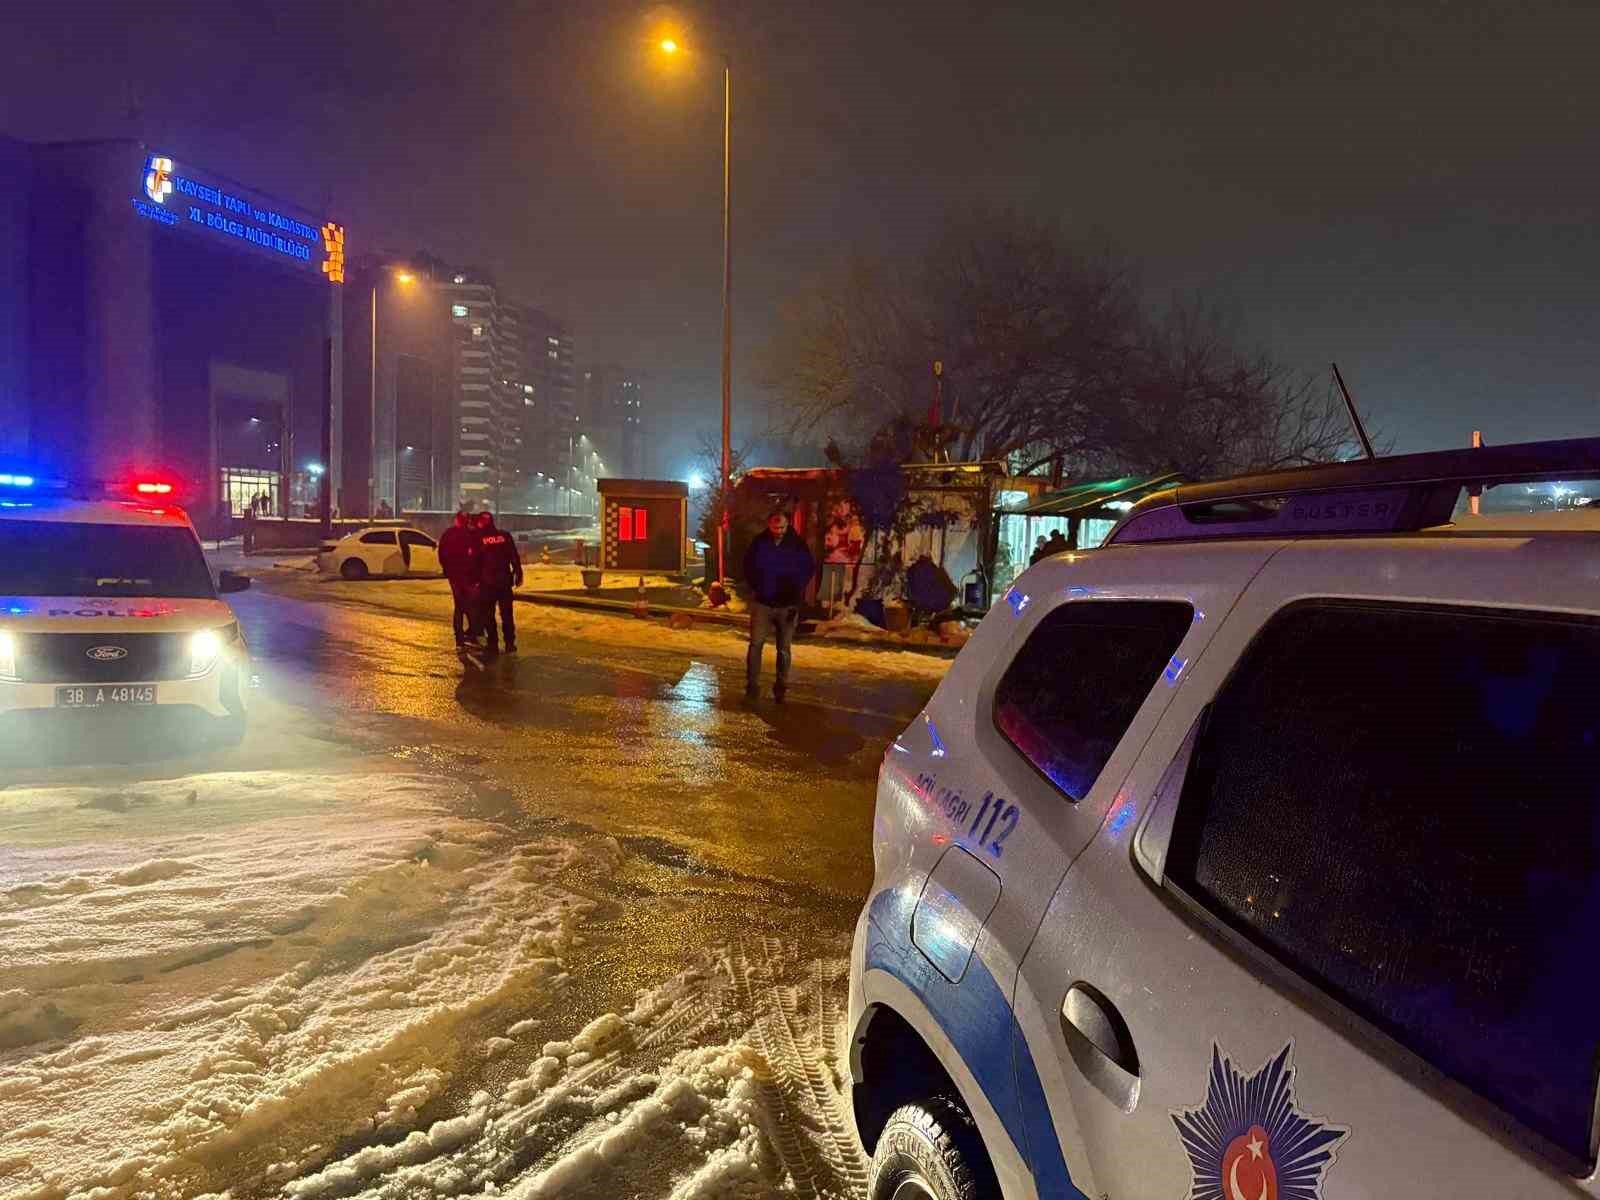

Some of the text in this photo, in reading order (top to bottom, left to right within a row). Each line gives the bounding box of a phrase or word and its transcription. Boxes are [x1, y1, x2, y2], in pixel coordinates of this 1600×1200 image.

[176, 176, 222, 206] KAYSERİ
[224, 195, 252, 215] TAPU
[268, 212, 318, 241] KADASTRO
[207, 212, 244, 238] BÖLGE
[246, 227, 310, 260] MÜDÜRLÜĞÜ
[95, 648, 121, 658] Ford
[95, 688, 105, 702] A
[967, 790, 1020, 858] 112
